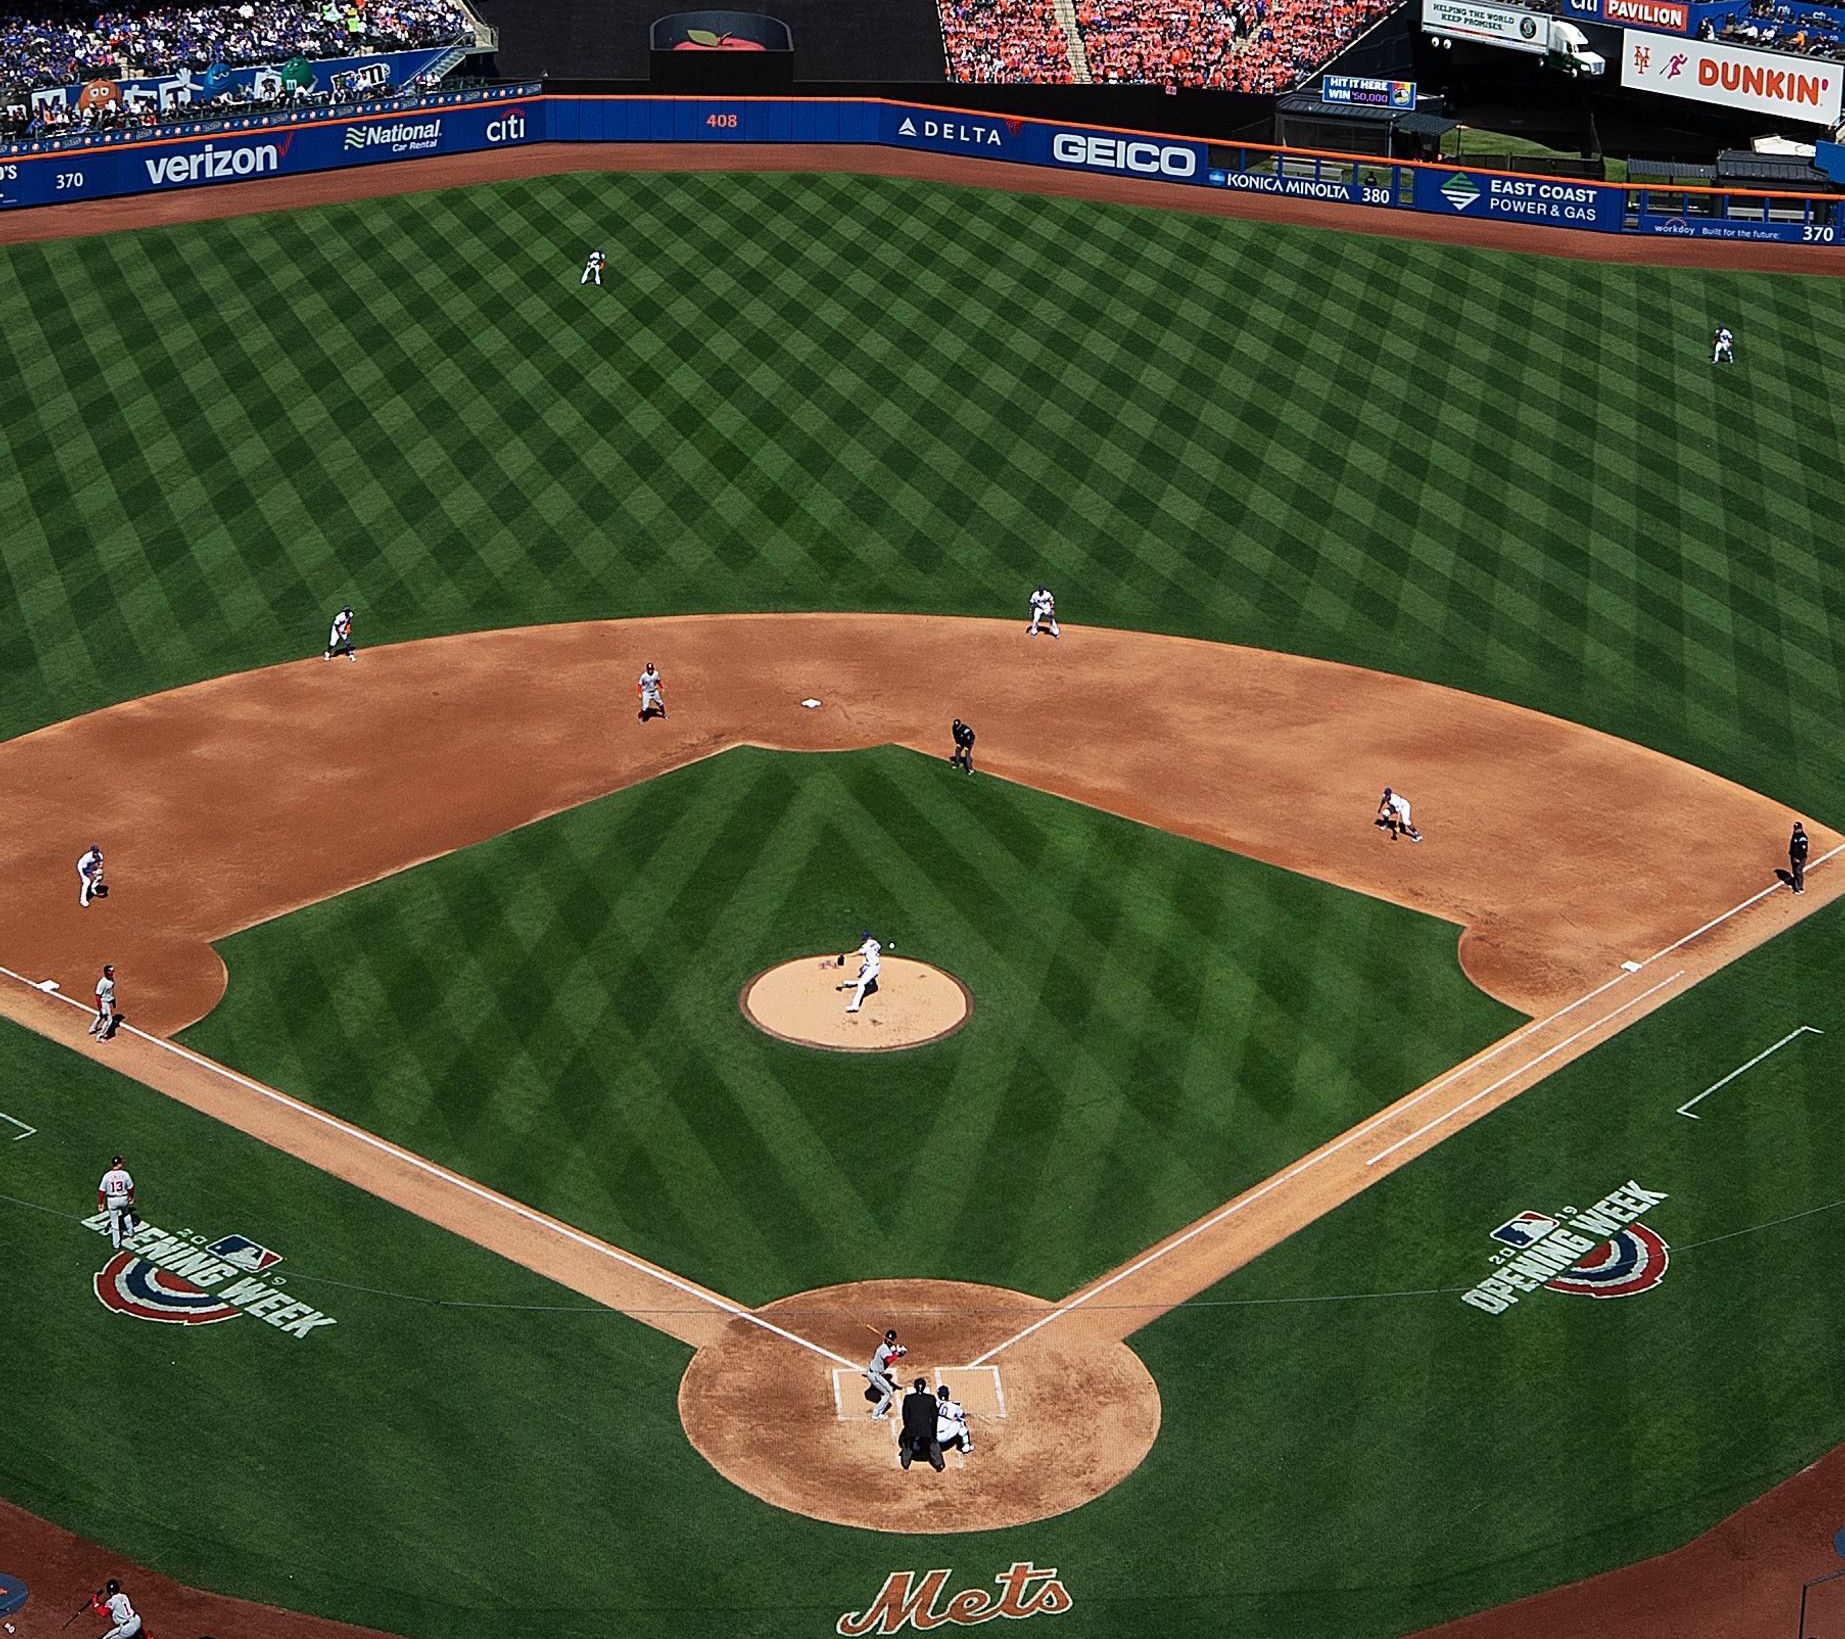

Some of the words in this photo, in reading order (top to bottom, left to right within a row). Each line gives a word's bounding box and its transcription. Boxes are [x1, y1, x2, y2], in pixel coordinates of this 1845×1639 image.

[1433, 3, 1467, 16] HELPING
[1469, 9, 1486, 19] THE
[1487, 12, 1515, 24] WORLD
[1441, 13, 1462, 23] KEEP
[1607, 0, 1683, 27] PAVILION
[1330, 77, 1348, 88] HIT
[1349, 79, 1358, 88] IT
[1360, 80, 1388, 91] HERE
[1698, 58, 1829, 106] DUNKIN'
[1328, 89, 1351, 100] WIN
[366, 119, 442, 145] National
[486, 114, 525, 142] citi
[706, 114, 738, 129] 408
[924, 120, 1001, 147] DELTA
[409, 139, 437, 150] Rental
[1053, 133, 1197, 177] GEICO
[145, 144, 277, 185] verizon
[56, 172, 84, 189] 370
[1227, 173, 1283, 192] KONICA
[1285, 180, 1349, 200] MINOLTA
[1491, 180, 1534, 198] EAST
[1538, 185, 1598, 204] COAST
[1362, 186, 1390, 204] 380
[1490, 198, 1547, 216] POWER
[1549, 204, 1561, 217] &
[1564, 205, 1596, 222] GAS
[1654, 224, 1695, 236] workday
[1702, 227, 1721, 236] Built
[1723, 228, 1736, 237] for
[1738, 229, 1751, 238] the
[1802, 226, 1834, 242] 370
[110, 1180, 123, 1193] 13
[1461, 1228, 1596, 1315] OPENING
[1568, 1179, 1670, 1237] WEEK
[1488, 1247, 1517, 1266] 20
[1554, 1205, 1578, 1220] 19
[218, 1276, 337, 1339] WEEK
[836, 1561, 1074, 1637] Mets
